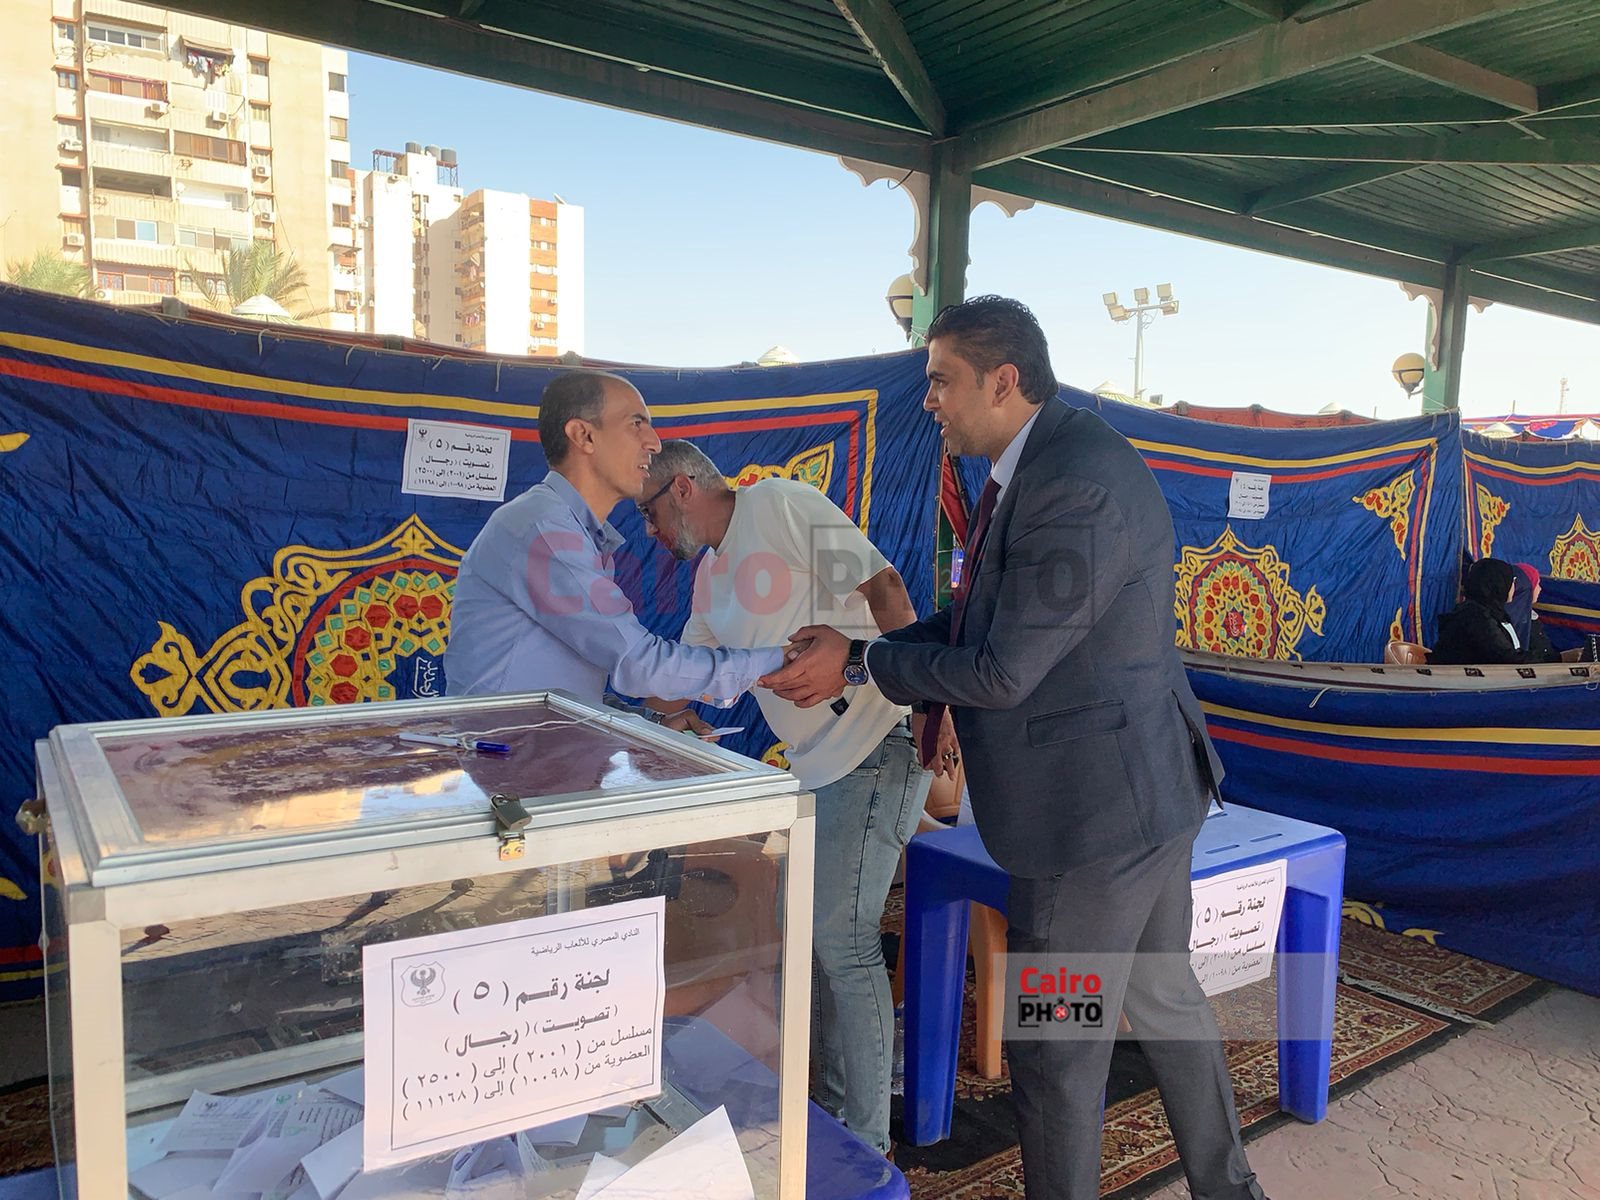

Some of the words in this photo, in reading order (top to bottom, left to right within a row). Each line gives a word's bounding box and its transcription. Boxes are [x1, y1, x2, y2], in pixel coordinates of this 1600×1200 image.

[475, 444, 493, 456] لجنة
[591, 932, 619, 947] المصري
[621, 928, 640, 941] النادي
[530, 943, 562, 956] الرياضية
[564, 937, 590, 949] للألعاب
[574, 968, 610, 994] لجنة
[515, 977, 569, 1012] رقم
[610, 1025, 652, 1046] مسلسل
[587, 1038, 606, 1054] من
[604, 1044, 650, 1068] العضوية
[483, 1056, 506, 1078] إلى
[584, 1062, 601, 1075] من
[483, 1080, 504, 1100] إلى
